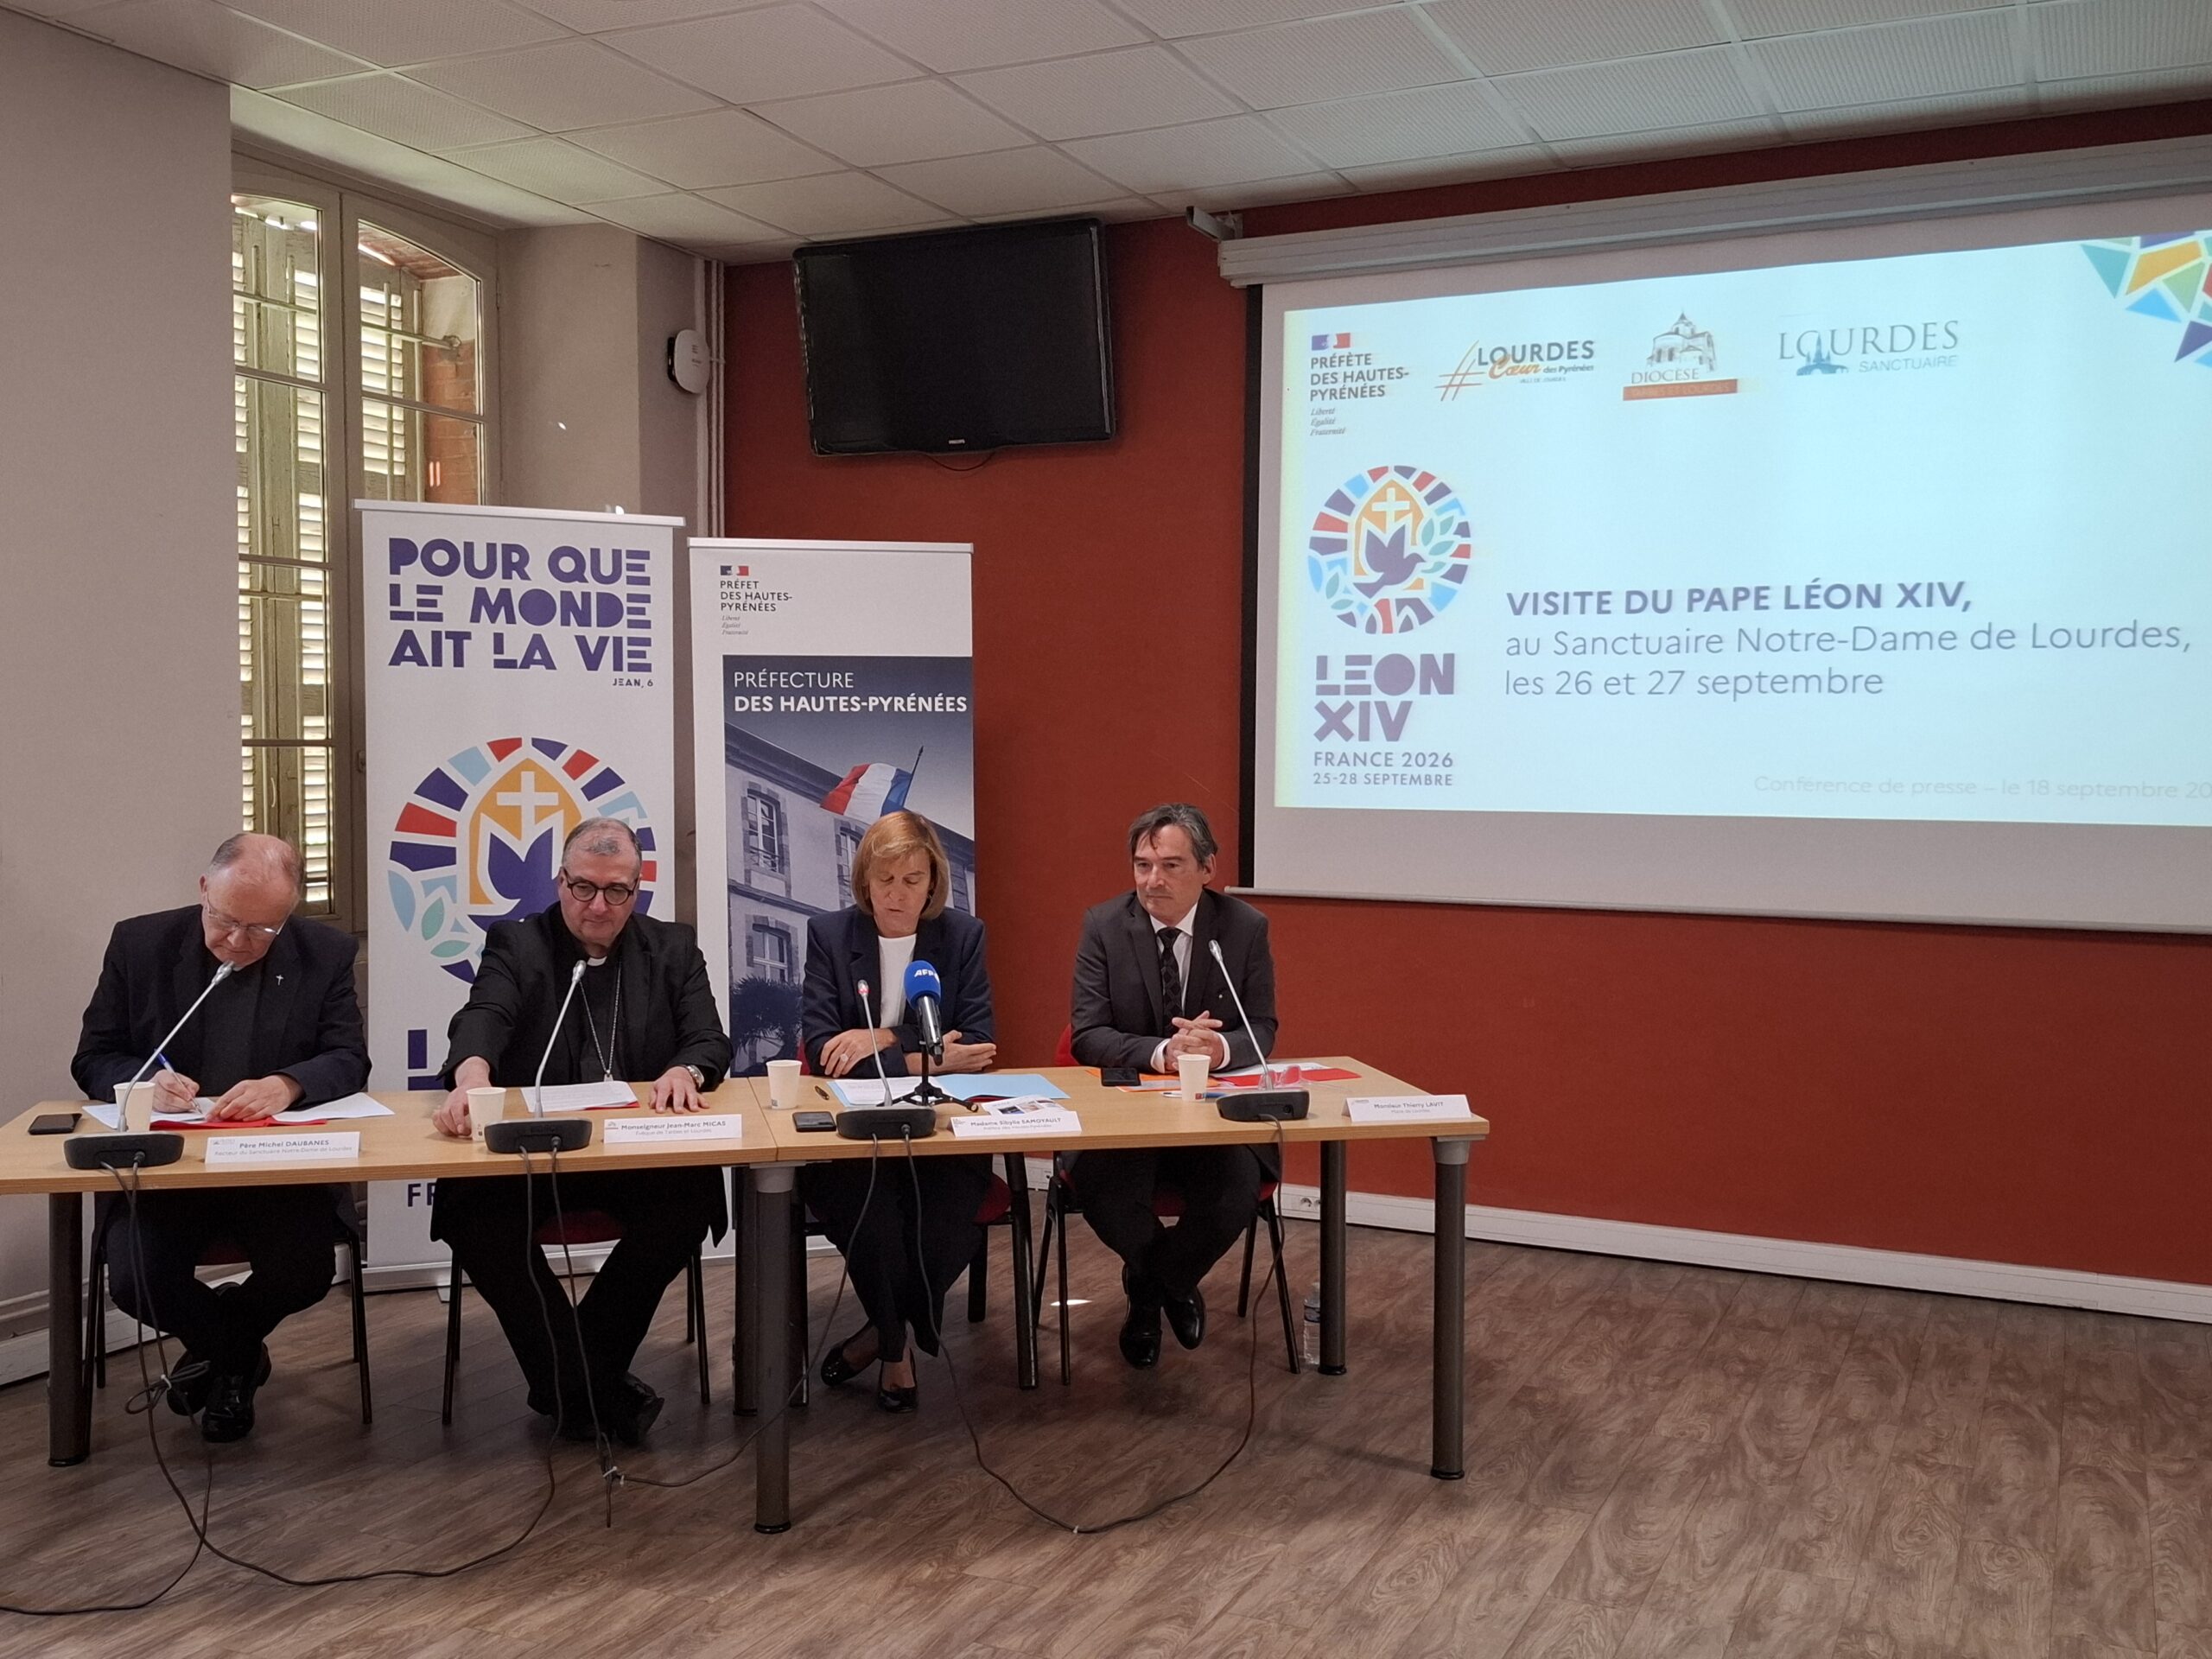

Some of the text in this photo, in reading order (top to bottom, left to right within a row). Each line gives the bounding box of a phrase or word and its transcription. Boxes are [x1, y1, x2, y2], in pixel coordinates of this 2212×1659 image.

[1310, 352, 1372, 370] PRÉFÈTE
[1859, 355, 1958, 373] SANCTUAIRE
[1311, 368, 1410, 386] DES HAUTES-
[1310, 384, 1386, 402] PYRÉNÉES
[389, 537, 651, 586] POUR QUE
[720, 579, 760, 589] PRÉFET
[721, 591, 792, 601] DES HAUTES-
[1506, 577, 1973, 615] VISITE DU PAPE LÉON XIV,
[389, 583, 652, 629] LE MONDE
[721, 601, 777, 612] PYRÉNÉES
[1506, 617, 2191, 657] au Sanctuaire Notre-Dame de Lourdes,
[388, 629, 652, 673] AIT LA VIE
[612, 678, 654, 689] JEAN, 6
[734, 668, 855, 689] PRÉFECTURE
[1316, 652, 1455, 696] LEON
[1505, 667, 1885, 702] les 26 et 27 septembre
[734, 693, 968, 712] DES HAUTES-PYRÉNÉES
[1313, 699, 1414, 742] XIV
[1313, 752, 1453, 767] FRANCE 2026
[1313, 772, 1453, 786] 25-28 SEPTEMBRE
[1878, 778, 1905, 793] de
[1911, 779, 1977, 797] presse
[2001, 779, 2020, 795] le
[2027, 779, 2050, 796] 18
[2056, 780, 2178, 801] septembre
